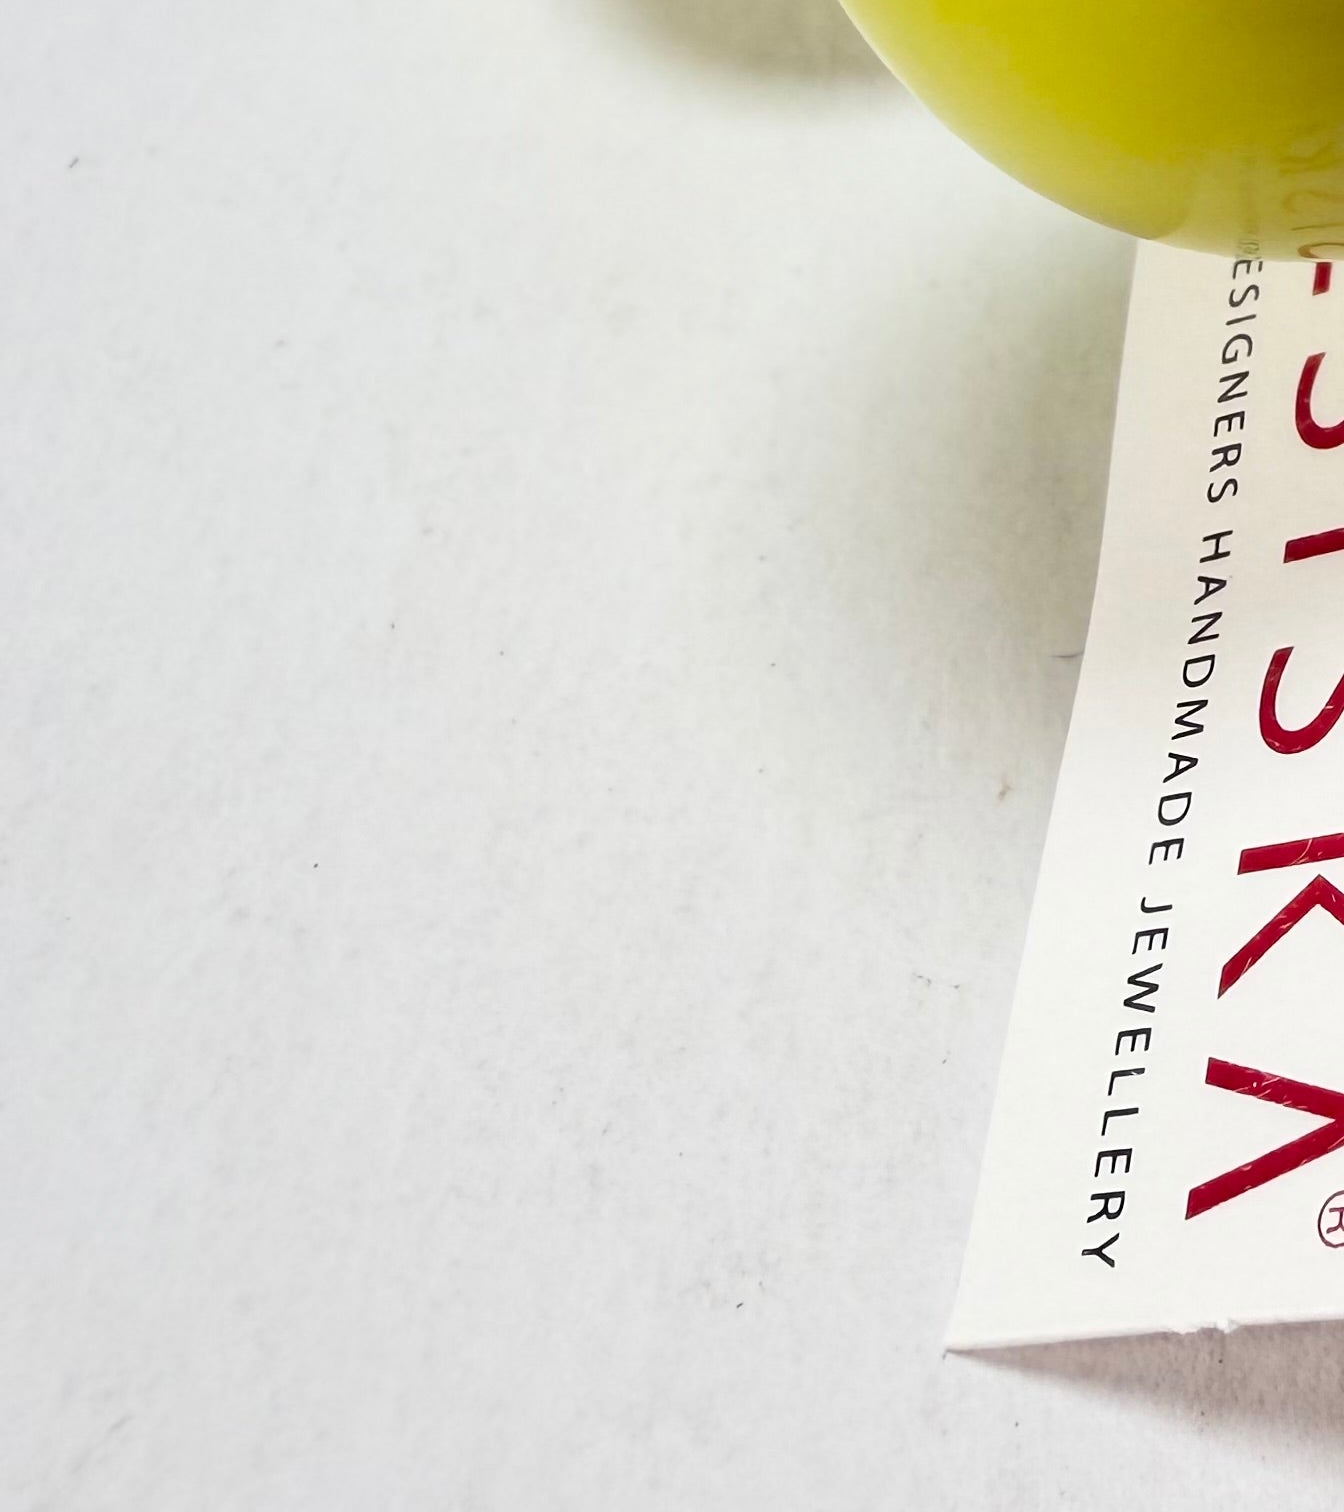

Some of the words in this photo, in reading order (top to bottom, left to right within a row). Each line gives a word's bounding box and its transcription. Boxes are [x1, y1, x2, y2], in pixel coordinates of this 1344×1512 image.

[1205, 258, 1264, 505] ESIGNERS
[1147, 529, 1234, 866] HANDMADE
[1081, 895, 1173, 1268] JEWELLERY
